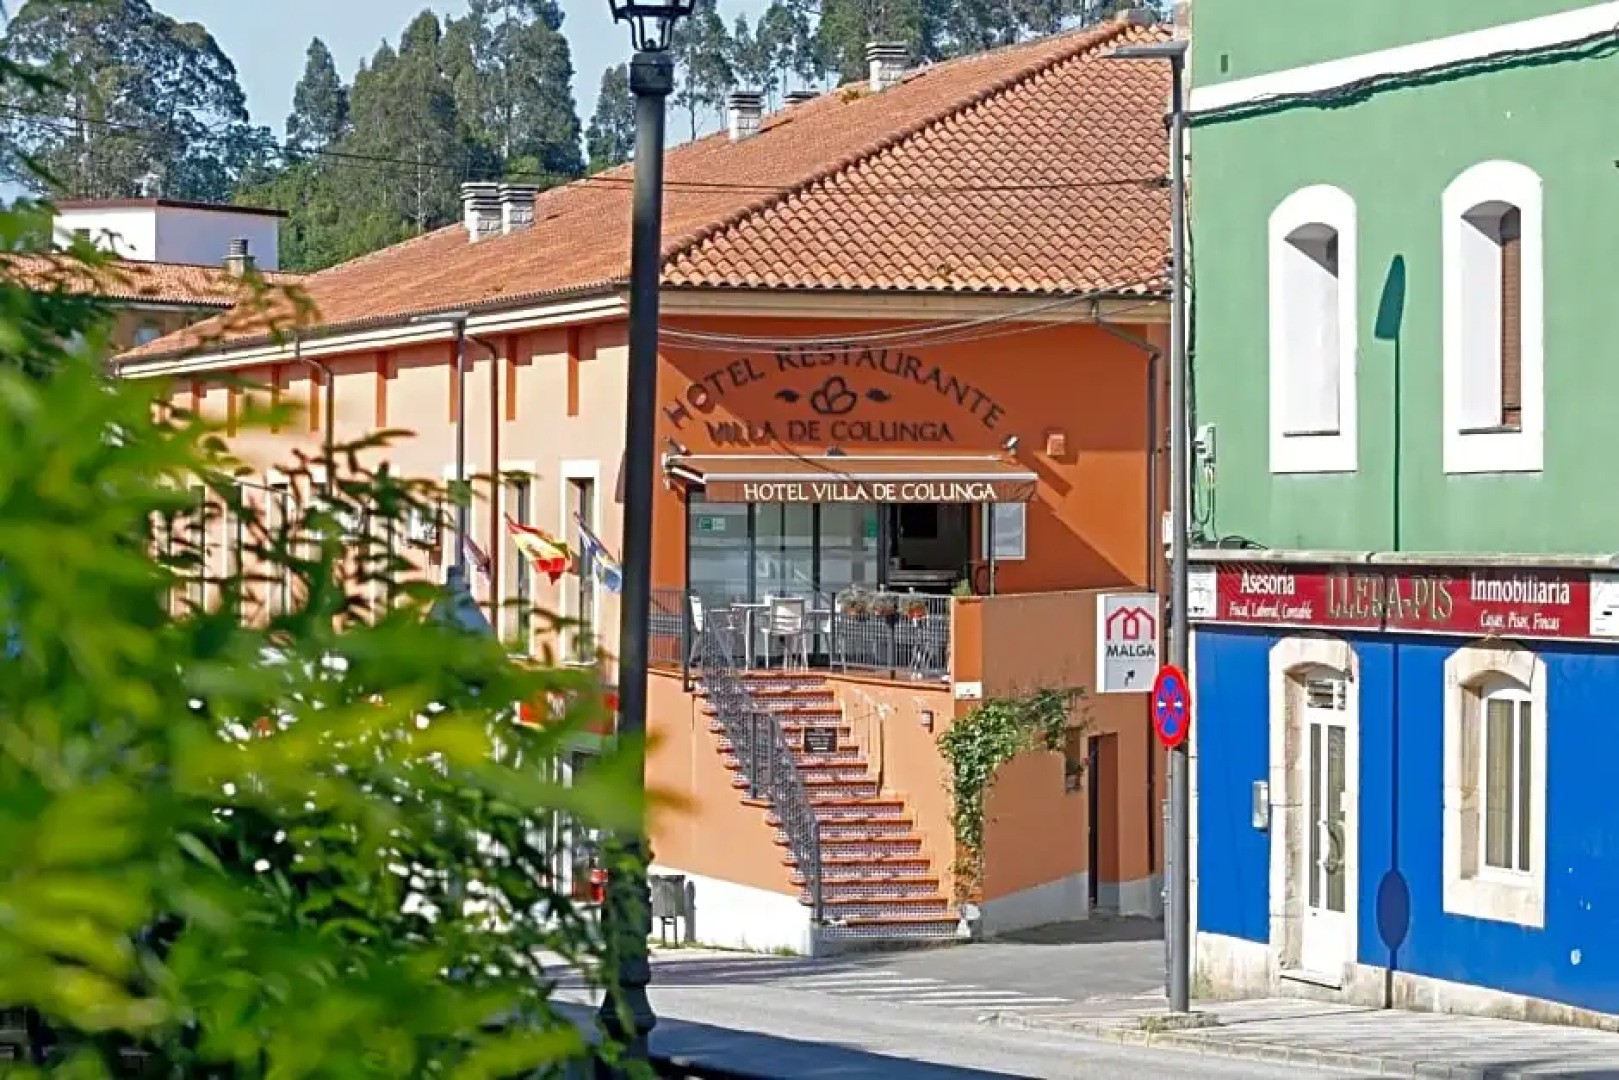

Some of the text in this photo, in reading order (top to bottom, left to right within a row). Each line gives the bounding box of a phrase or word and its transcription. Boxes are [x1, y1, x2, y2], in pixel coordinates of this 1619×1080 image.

[662, 343, 1006, 430] HOTEL RESTAURANTE
[706, 420, 955, 446] VILLA DE COLUNGA
[743, 483, 998, 501] HOTEL VILLA DE COLUNGA
[1470, 572, 1570, 604] Inmobiliaria
[1106, 645, 1156, 657] MALGA
